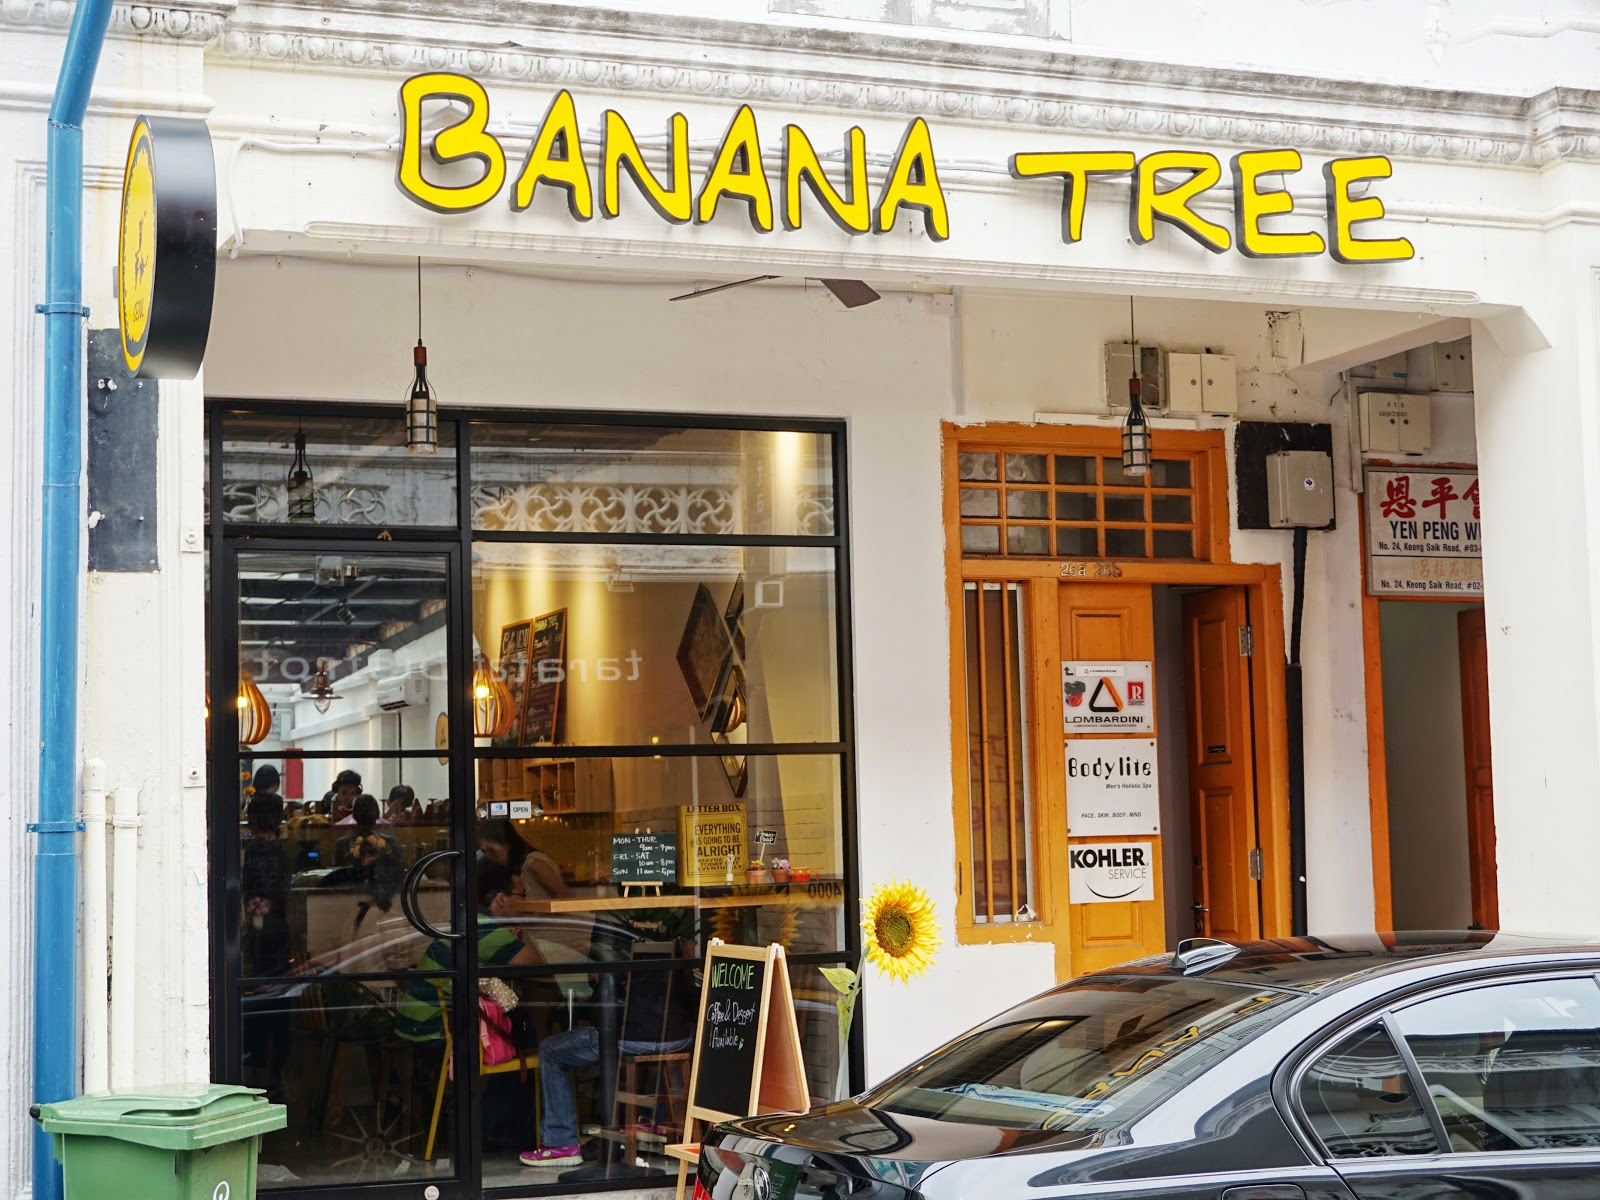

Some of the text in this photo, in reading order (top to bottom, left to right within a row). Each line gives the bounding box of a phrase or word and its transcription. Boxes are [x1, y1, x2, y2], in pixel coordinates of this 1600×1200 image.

[399, 73, 1415, 264] BANANA TREE
[1390, 521, 1418, 540] YEN
[1423, 522, 1459, 540] PENG
[1379, 542, 1389, 550] No.
[1392, 543, 1402, 552] 24,
[1404, 543, 1424, 553] Keong
[1426, 543, 1441, 552] Saik
[1443, 544, 1461, 553] Road,
[1060, 562, 1086, 577] 26a
[1381, 580, 1392, 588] No.
[1406, 581, 1426, 590] Keong
[1429, 581, 1443, 589] Saik
[1446, 581, 1464, 590] Road,
[1068, 757, 1151, 780] Bodylite
[687, 803, 741, 813] LETTER BOX
[695, 822, 740, 835] EVERYTHING
[696, 835, 740, 845] IS GOING TO BE
[697, 844, 741, 857] ALRIGHT
[1070, 848, 1145, 868] KOHLER
[1108, 868, 1146, 879] SERVICE
[712, 963, 754, 990] WELCOME
